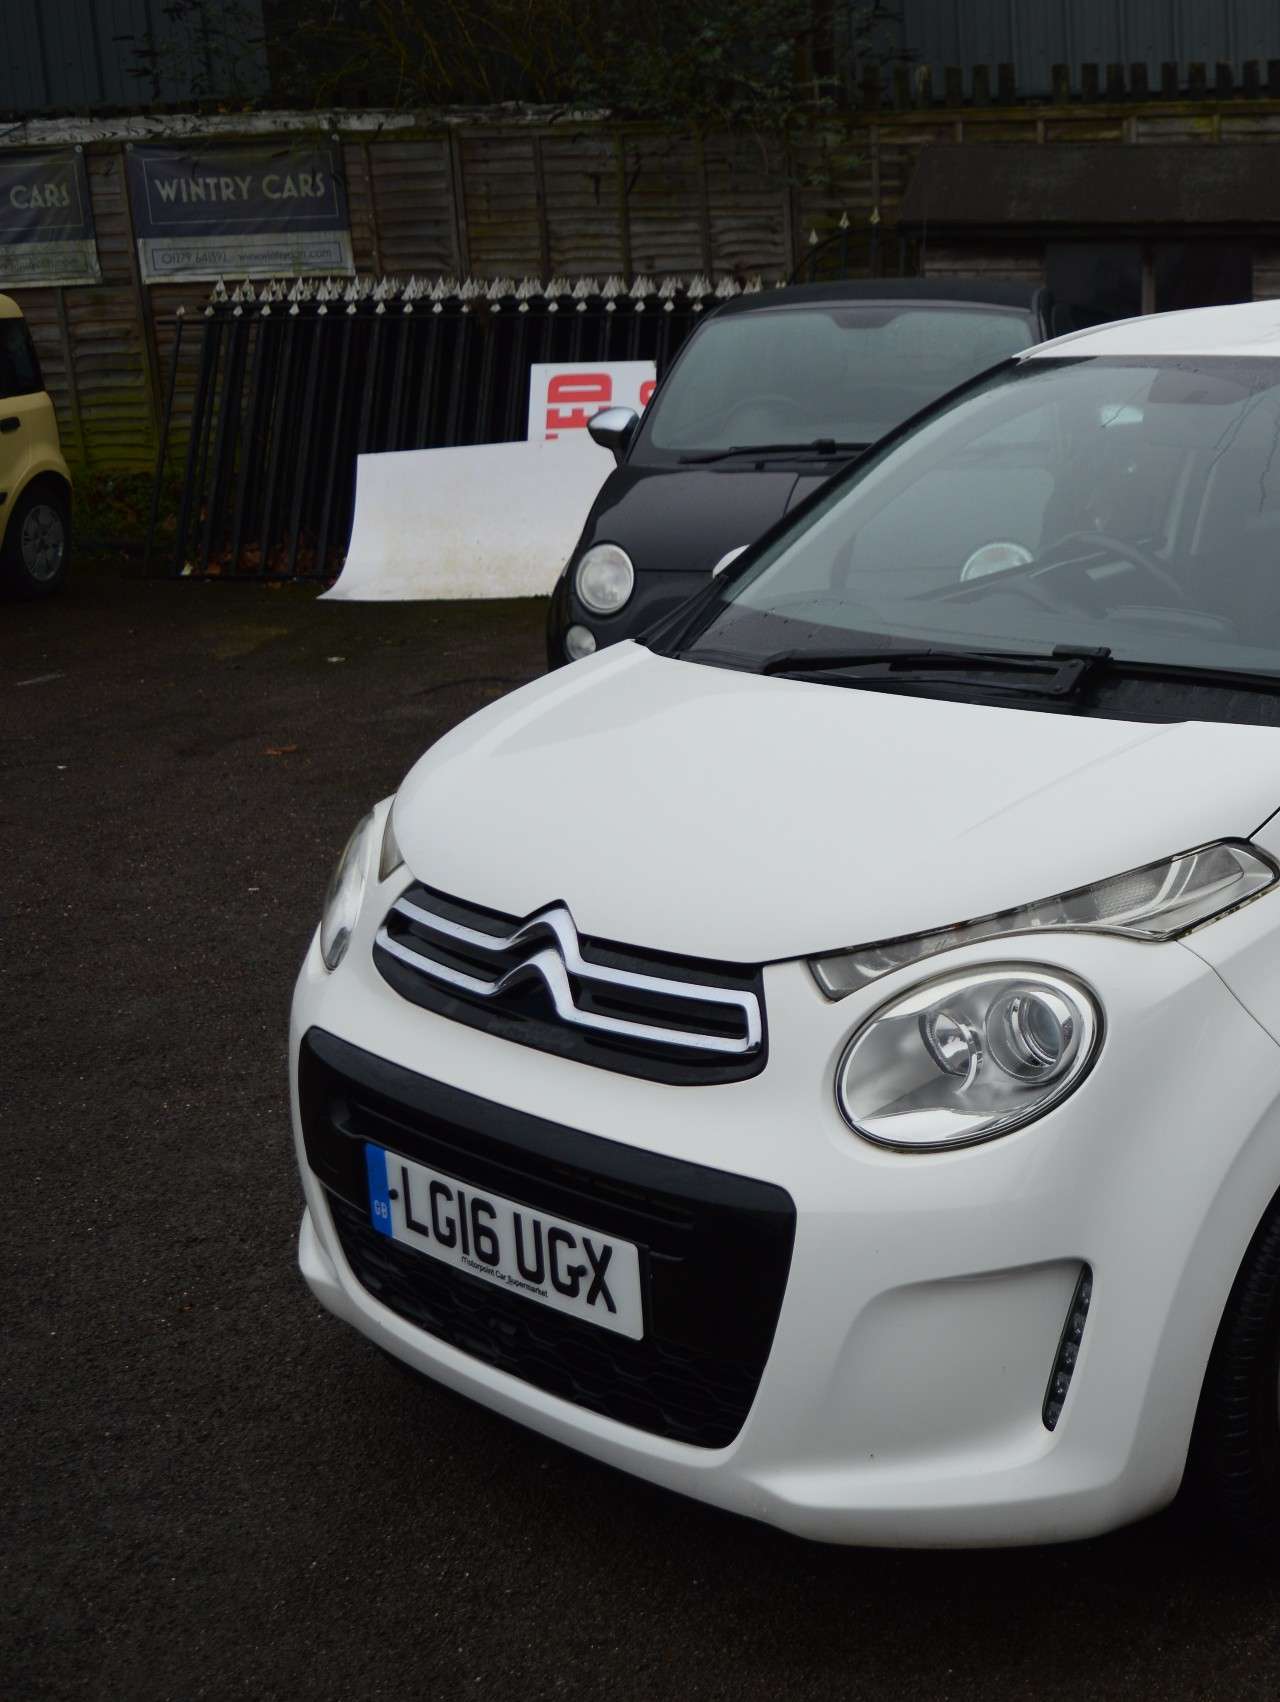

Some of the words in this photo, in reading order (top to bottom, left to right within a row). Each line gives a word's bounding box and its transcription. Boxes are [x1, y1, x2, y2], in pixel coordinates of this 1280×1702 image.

[10, 182, 71, 209] CARS
[154, 175, 252, 203] WINTRY
[263, 172, 325, 199] CARS
[374, 1199, 388, 1219] GB
[401, 1166, 500, 1267] LG16
[513, 1211, 617, 1314] UGX
[495, 1270, 507, 1281] Car
[507, 1275, 549, 1298] Supermarket
